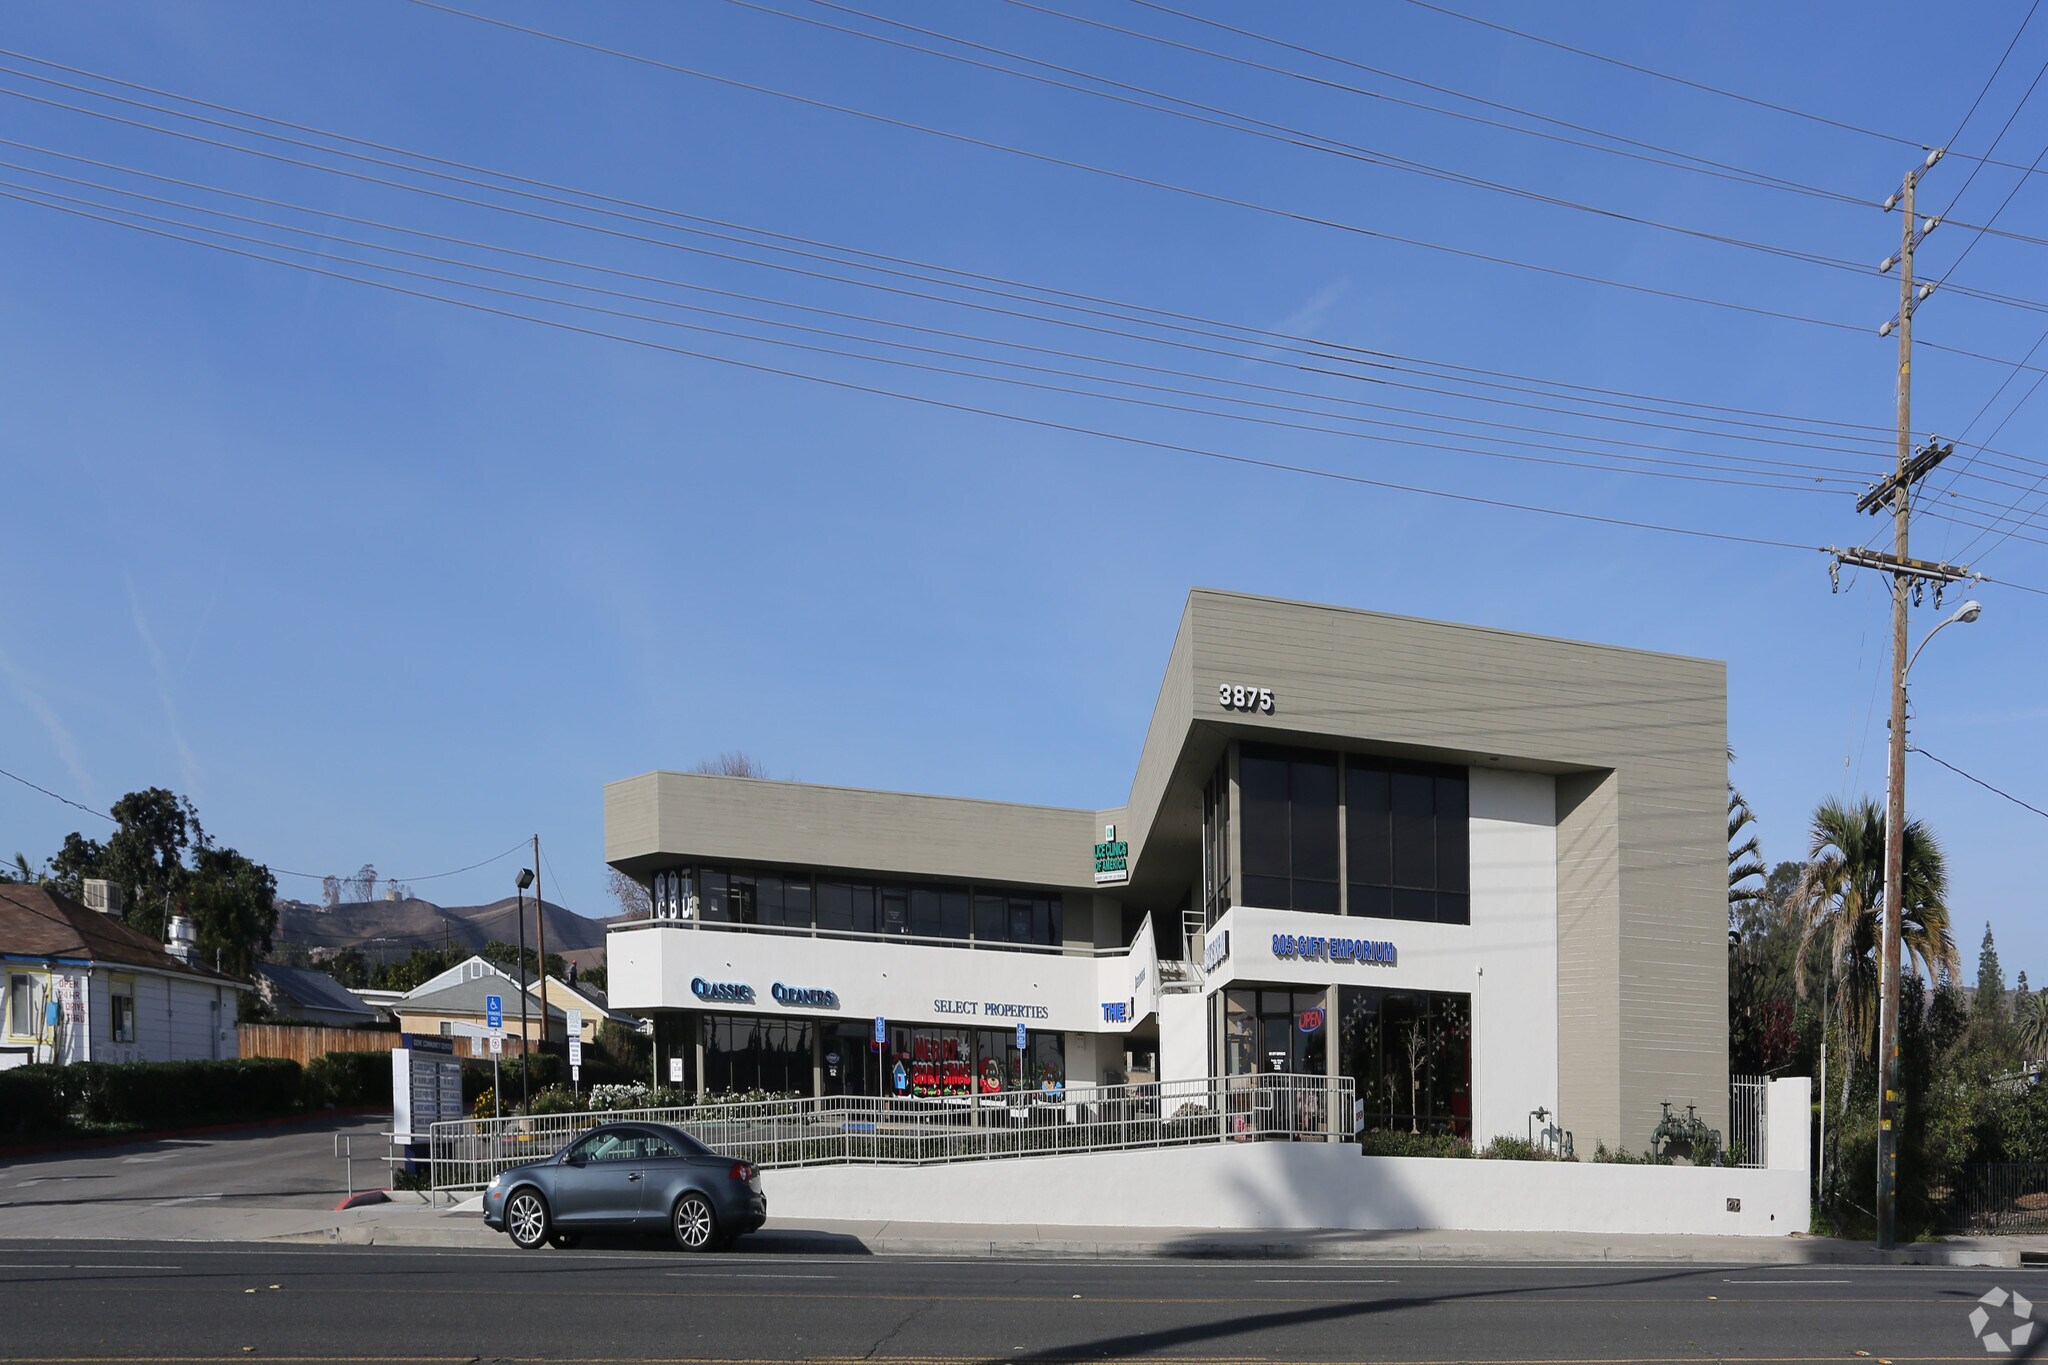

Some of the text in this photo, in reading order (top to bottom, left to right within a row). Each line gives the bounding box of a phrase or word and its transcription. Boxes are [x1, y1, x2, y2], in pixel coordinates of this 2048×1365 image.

[1219, 684, 1272, 711] 3875
[1094, 841, 1128, 858] LICE CLINICS
[1095, 859, 1127, 872] OF AMERICA
[1272, 933, 1395, 963] 805 GIFT EMPORIUM
[59, 979, 79, 989] OPEN
[690, 977, 835, 1005] CLASSIC CLEANERS
[58, 991, 80, 1000] 24 HR
[65, 1003, 85, 1012] DRIVE
[934, 999, 1049, 1019] SELECT PROPERTIES
[1101, 1002, 1124, 1021] THE
[66, 1013, 85, 1023] THRU
[1299, 1011, 1322, 1028] OPEN
[914, 1035, 959, 1061] MERRY
[912, 1061, 971, 1086] CHRISTMAS
